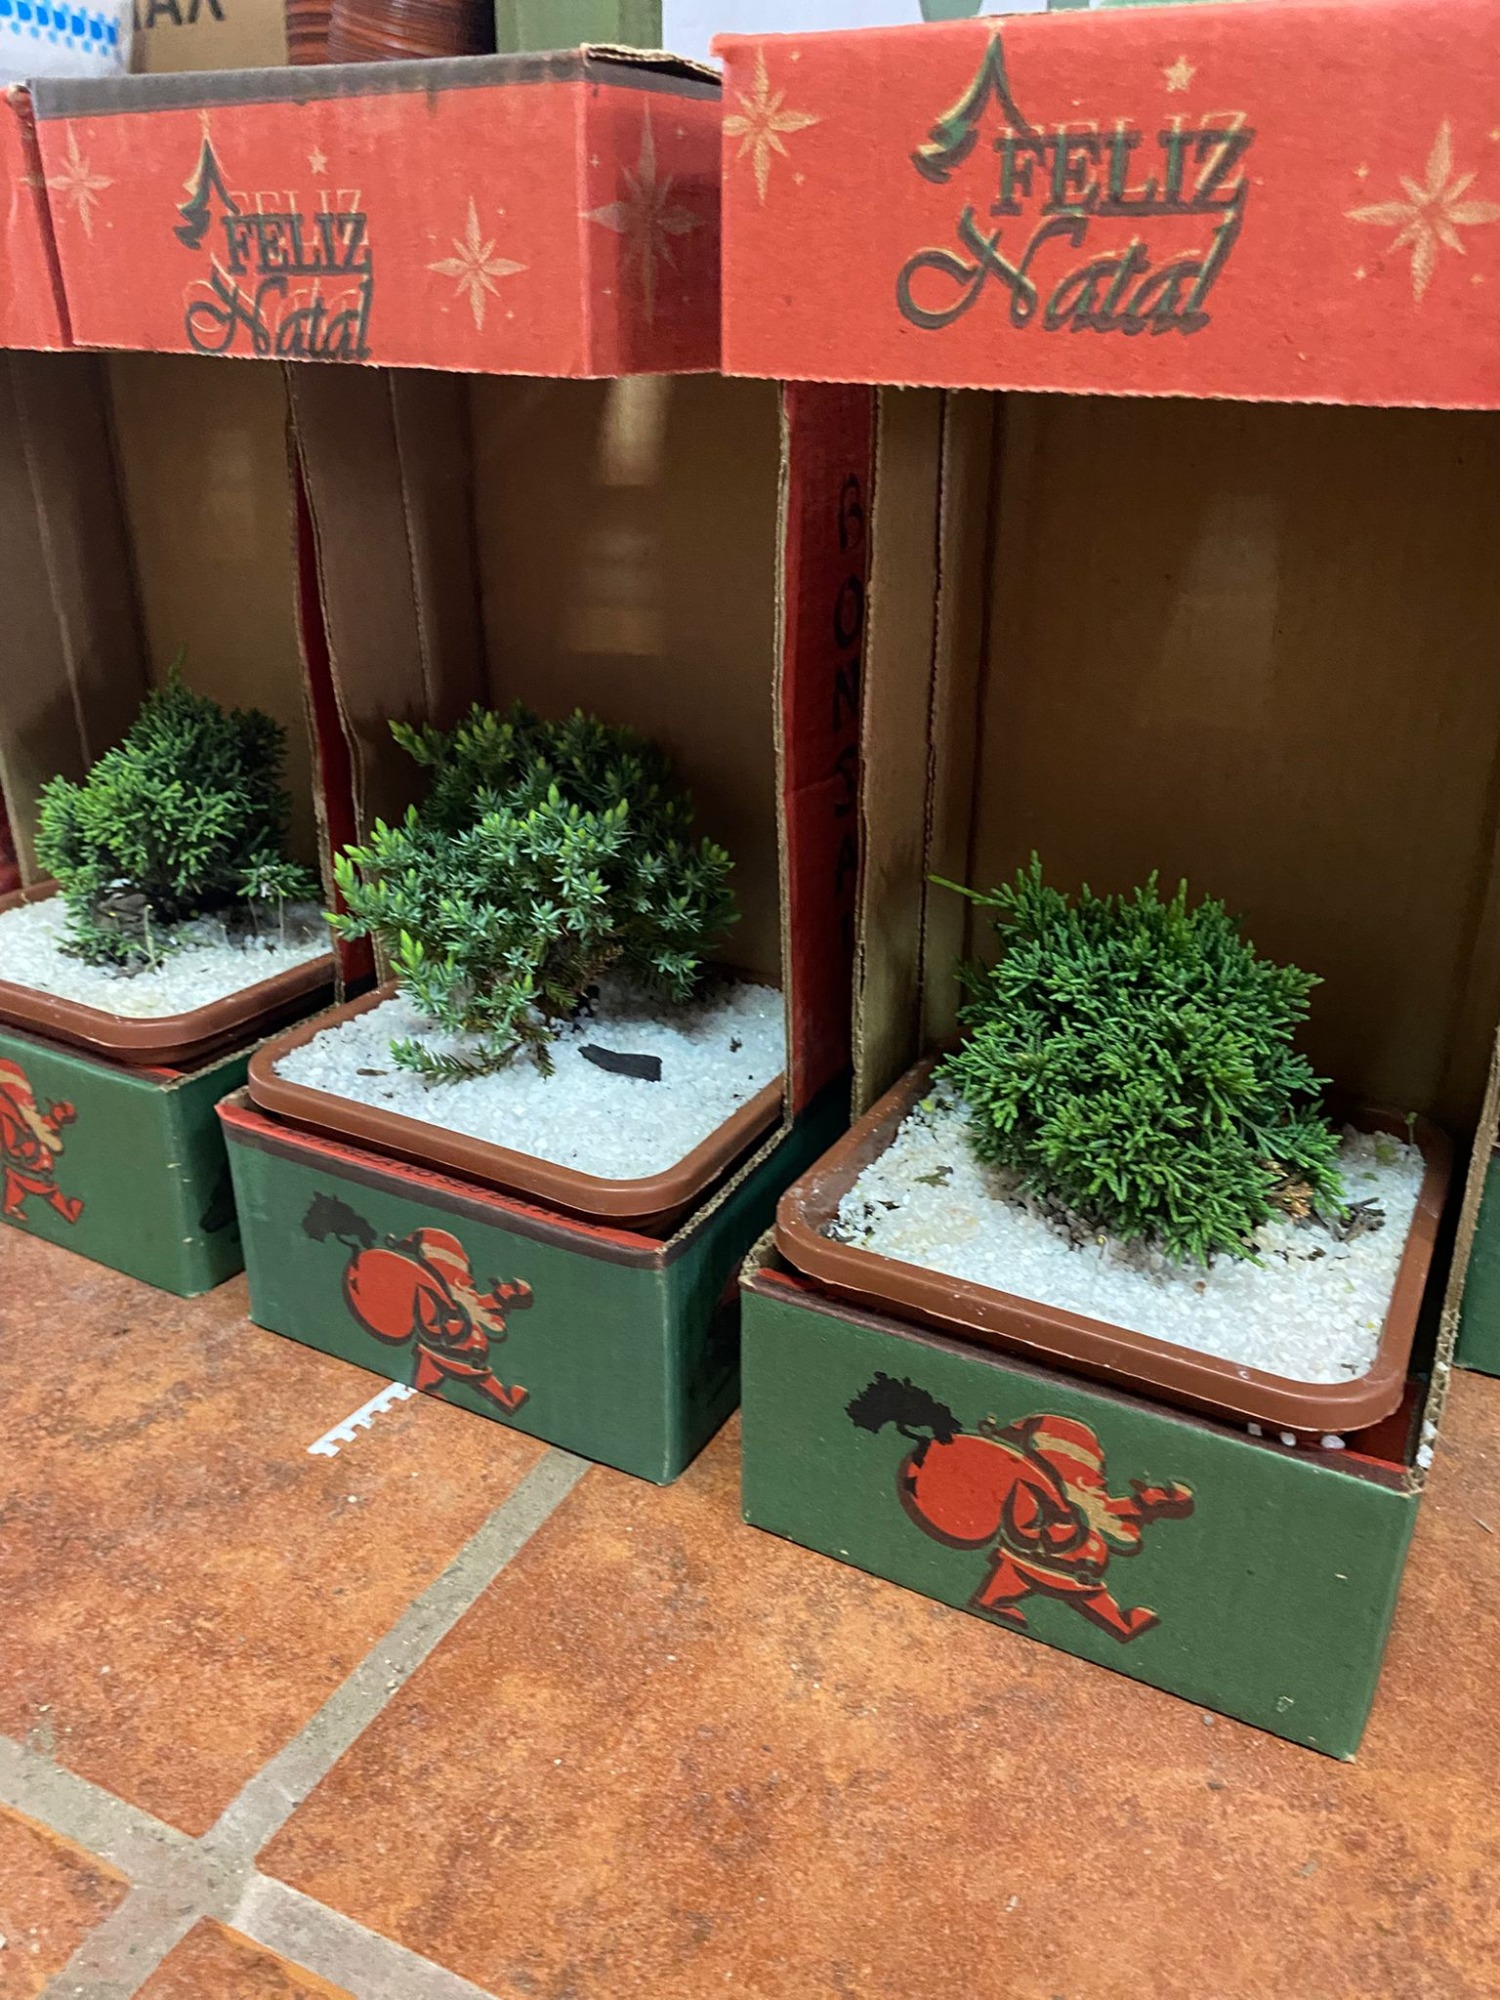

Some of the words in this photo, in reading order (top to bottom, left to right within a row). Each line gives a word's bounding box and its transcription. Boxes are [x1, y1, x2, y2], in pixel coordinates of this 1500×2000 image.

[990, 111, 1256, 218] FELIZ
[221, 190, 369, 276] FELIZ
[895, 181, 1249, 336] Natal
[184, 250, 374, 359] Natal
